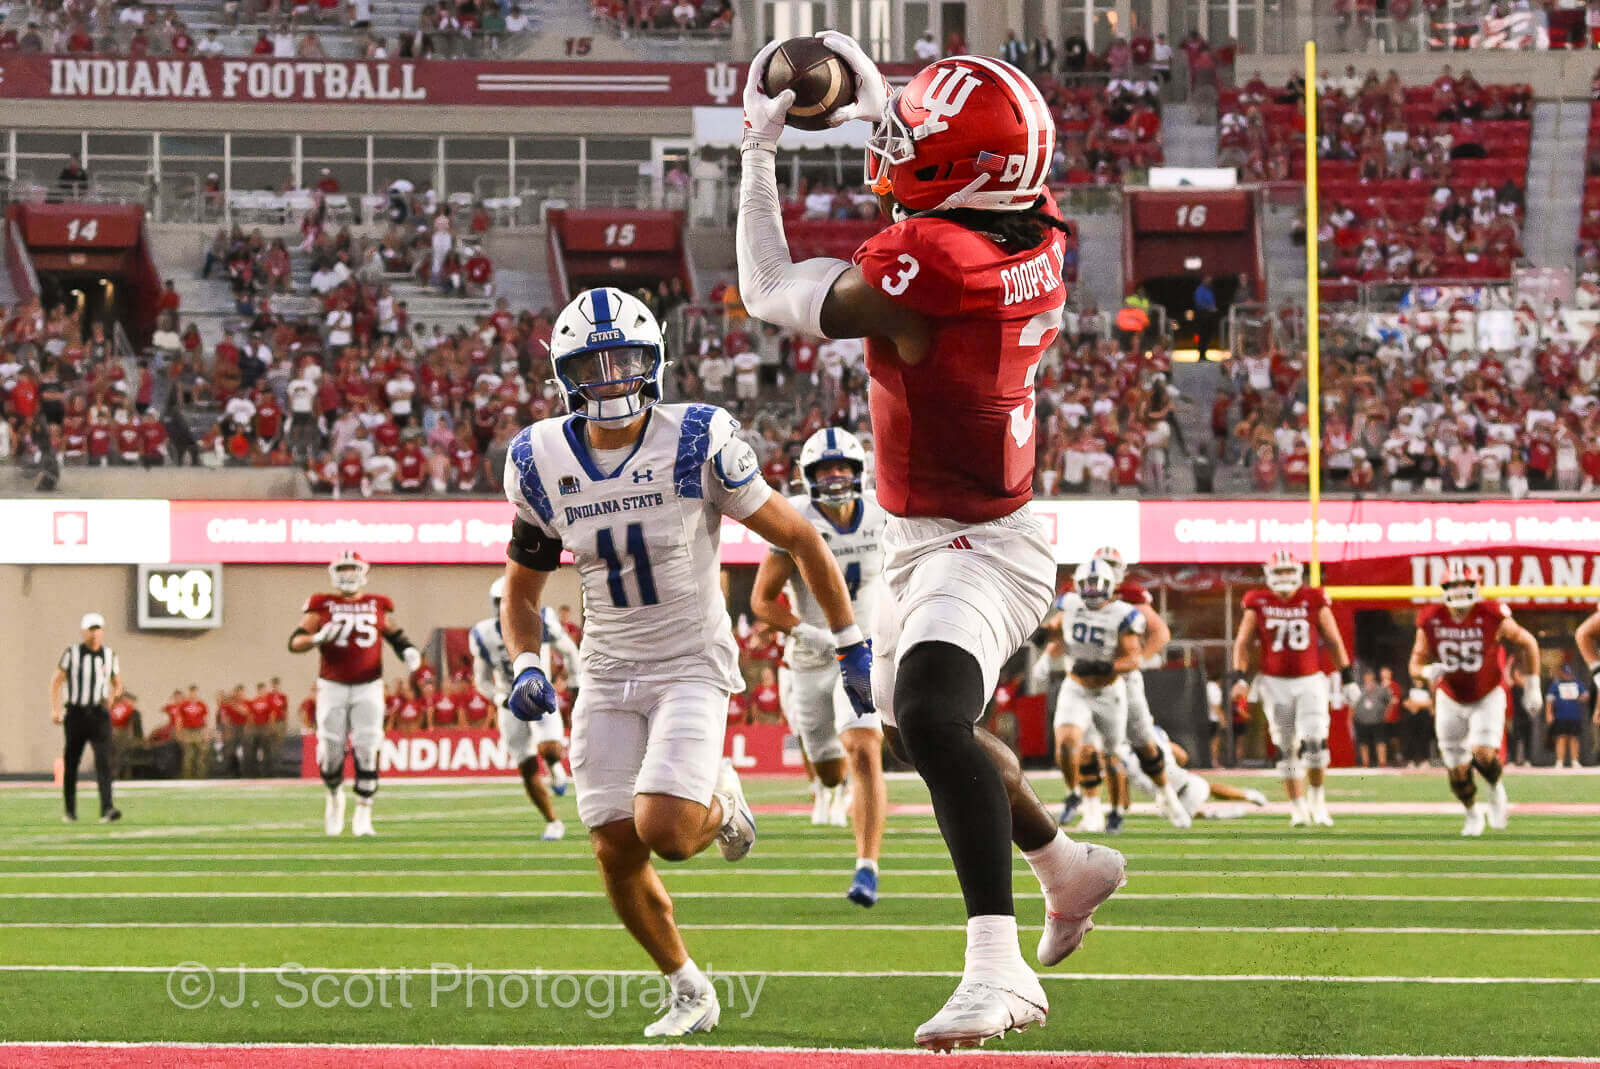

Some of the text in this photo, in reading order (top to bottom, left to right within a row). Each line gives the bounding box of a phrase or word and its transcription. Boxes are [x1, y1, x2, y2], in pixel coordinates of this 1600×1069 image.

[565, 36, 593, 57] 15
[50, 58, 426, 99] INDIANA FOOTBALL
[66, 218, 98, 241] 14
[1176, 204, 1208, 227] 16
[604, 223, 636, 246] 15
[882, 253, 920, 296] 3
[1001, 252, 1060, 306] COOPER
[591, 330, 620, 342] STATE
[622, 492, 664, 510] STATE
[1259, 518, 1383, 543] Healhcare
[596, 521, 659, 607] 11
[1411, 555, 1600, 604] INDIAN
[149, 568, 212, 619] 40
[331, 612, 378, 647] 75
[1265, 618, 1310, 652] 78
[1437, 640, 1484, 672] 65
[379, 737, 520, 771] NDIAN
